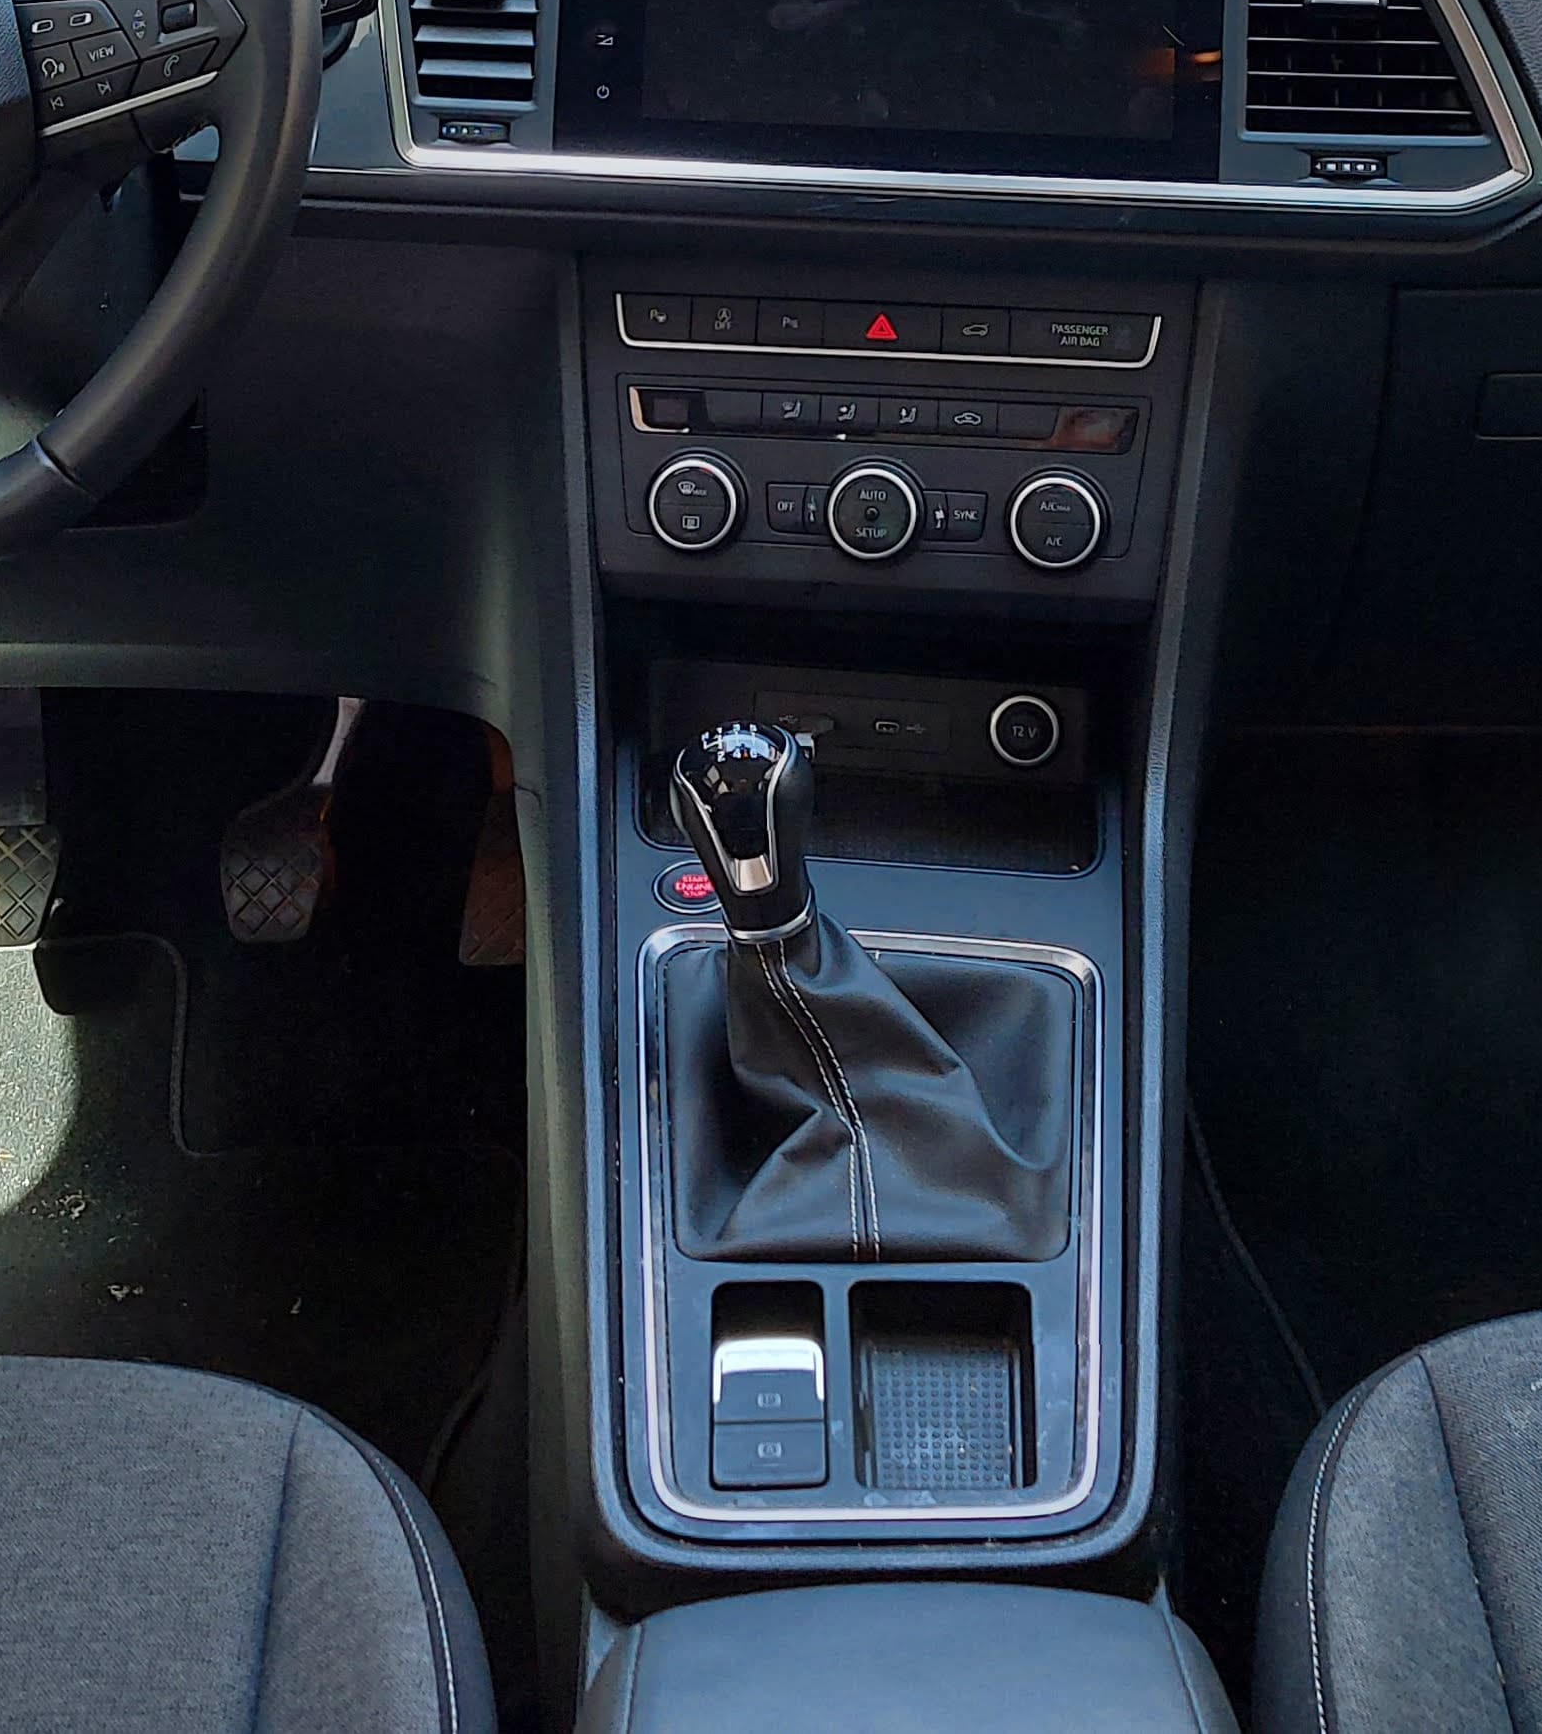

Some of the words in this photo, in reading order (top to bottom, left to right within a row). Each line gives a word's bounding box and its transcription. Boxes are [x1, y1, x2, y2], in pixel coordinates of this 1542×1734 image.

[88, 45, 115, 63] VIEW
[1051, 323, 1110, 336] PASSENGER
[859, 489, 887, 501] AUTO
[777, 500, 796, 512] OFF
[953, 509, 978, 521] SYNC
[855, 527, 888, 539] SETUP
[1045, 536, 1063, 547] A/C
[1028, 726, 1038, 739] V
